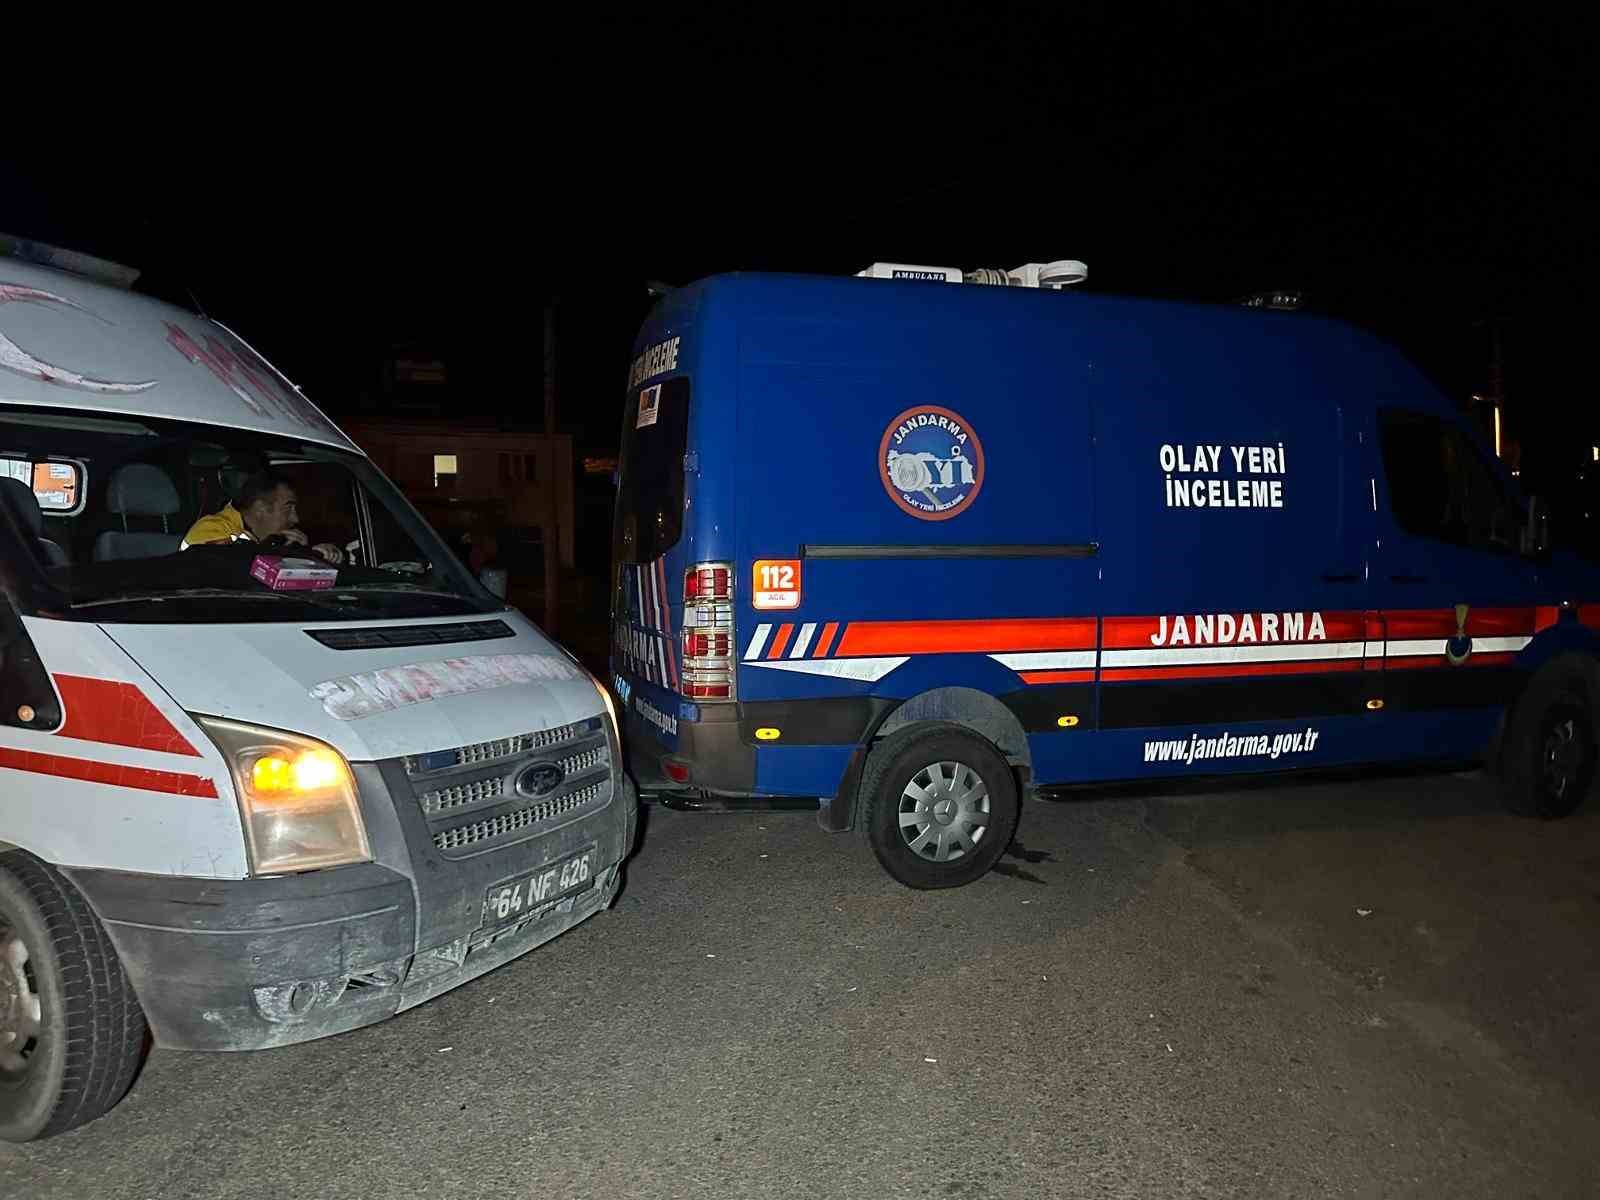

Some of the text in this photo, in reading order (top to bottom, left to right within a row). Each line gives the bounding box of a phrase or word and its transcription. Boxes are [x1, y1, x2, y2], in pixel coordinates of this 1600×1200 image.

[893, 414, 968, 445] JANDARMA
[1159, 442, 1286, 474] OLAY YERİ
[1165, 474, 1284, 508] İNCELEME
[760, 565, 794, 589] 112
[1150, 611, 1327, 646] JANDARMA
[1143, 727, 1319, 765] www.jandarma.gov.tr
[497, 883, 522, 919] 64
[527, 869, 557, 906] NF
[560, 854, 590, 889] 426
